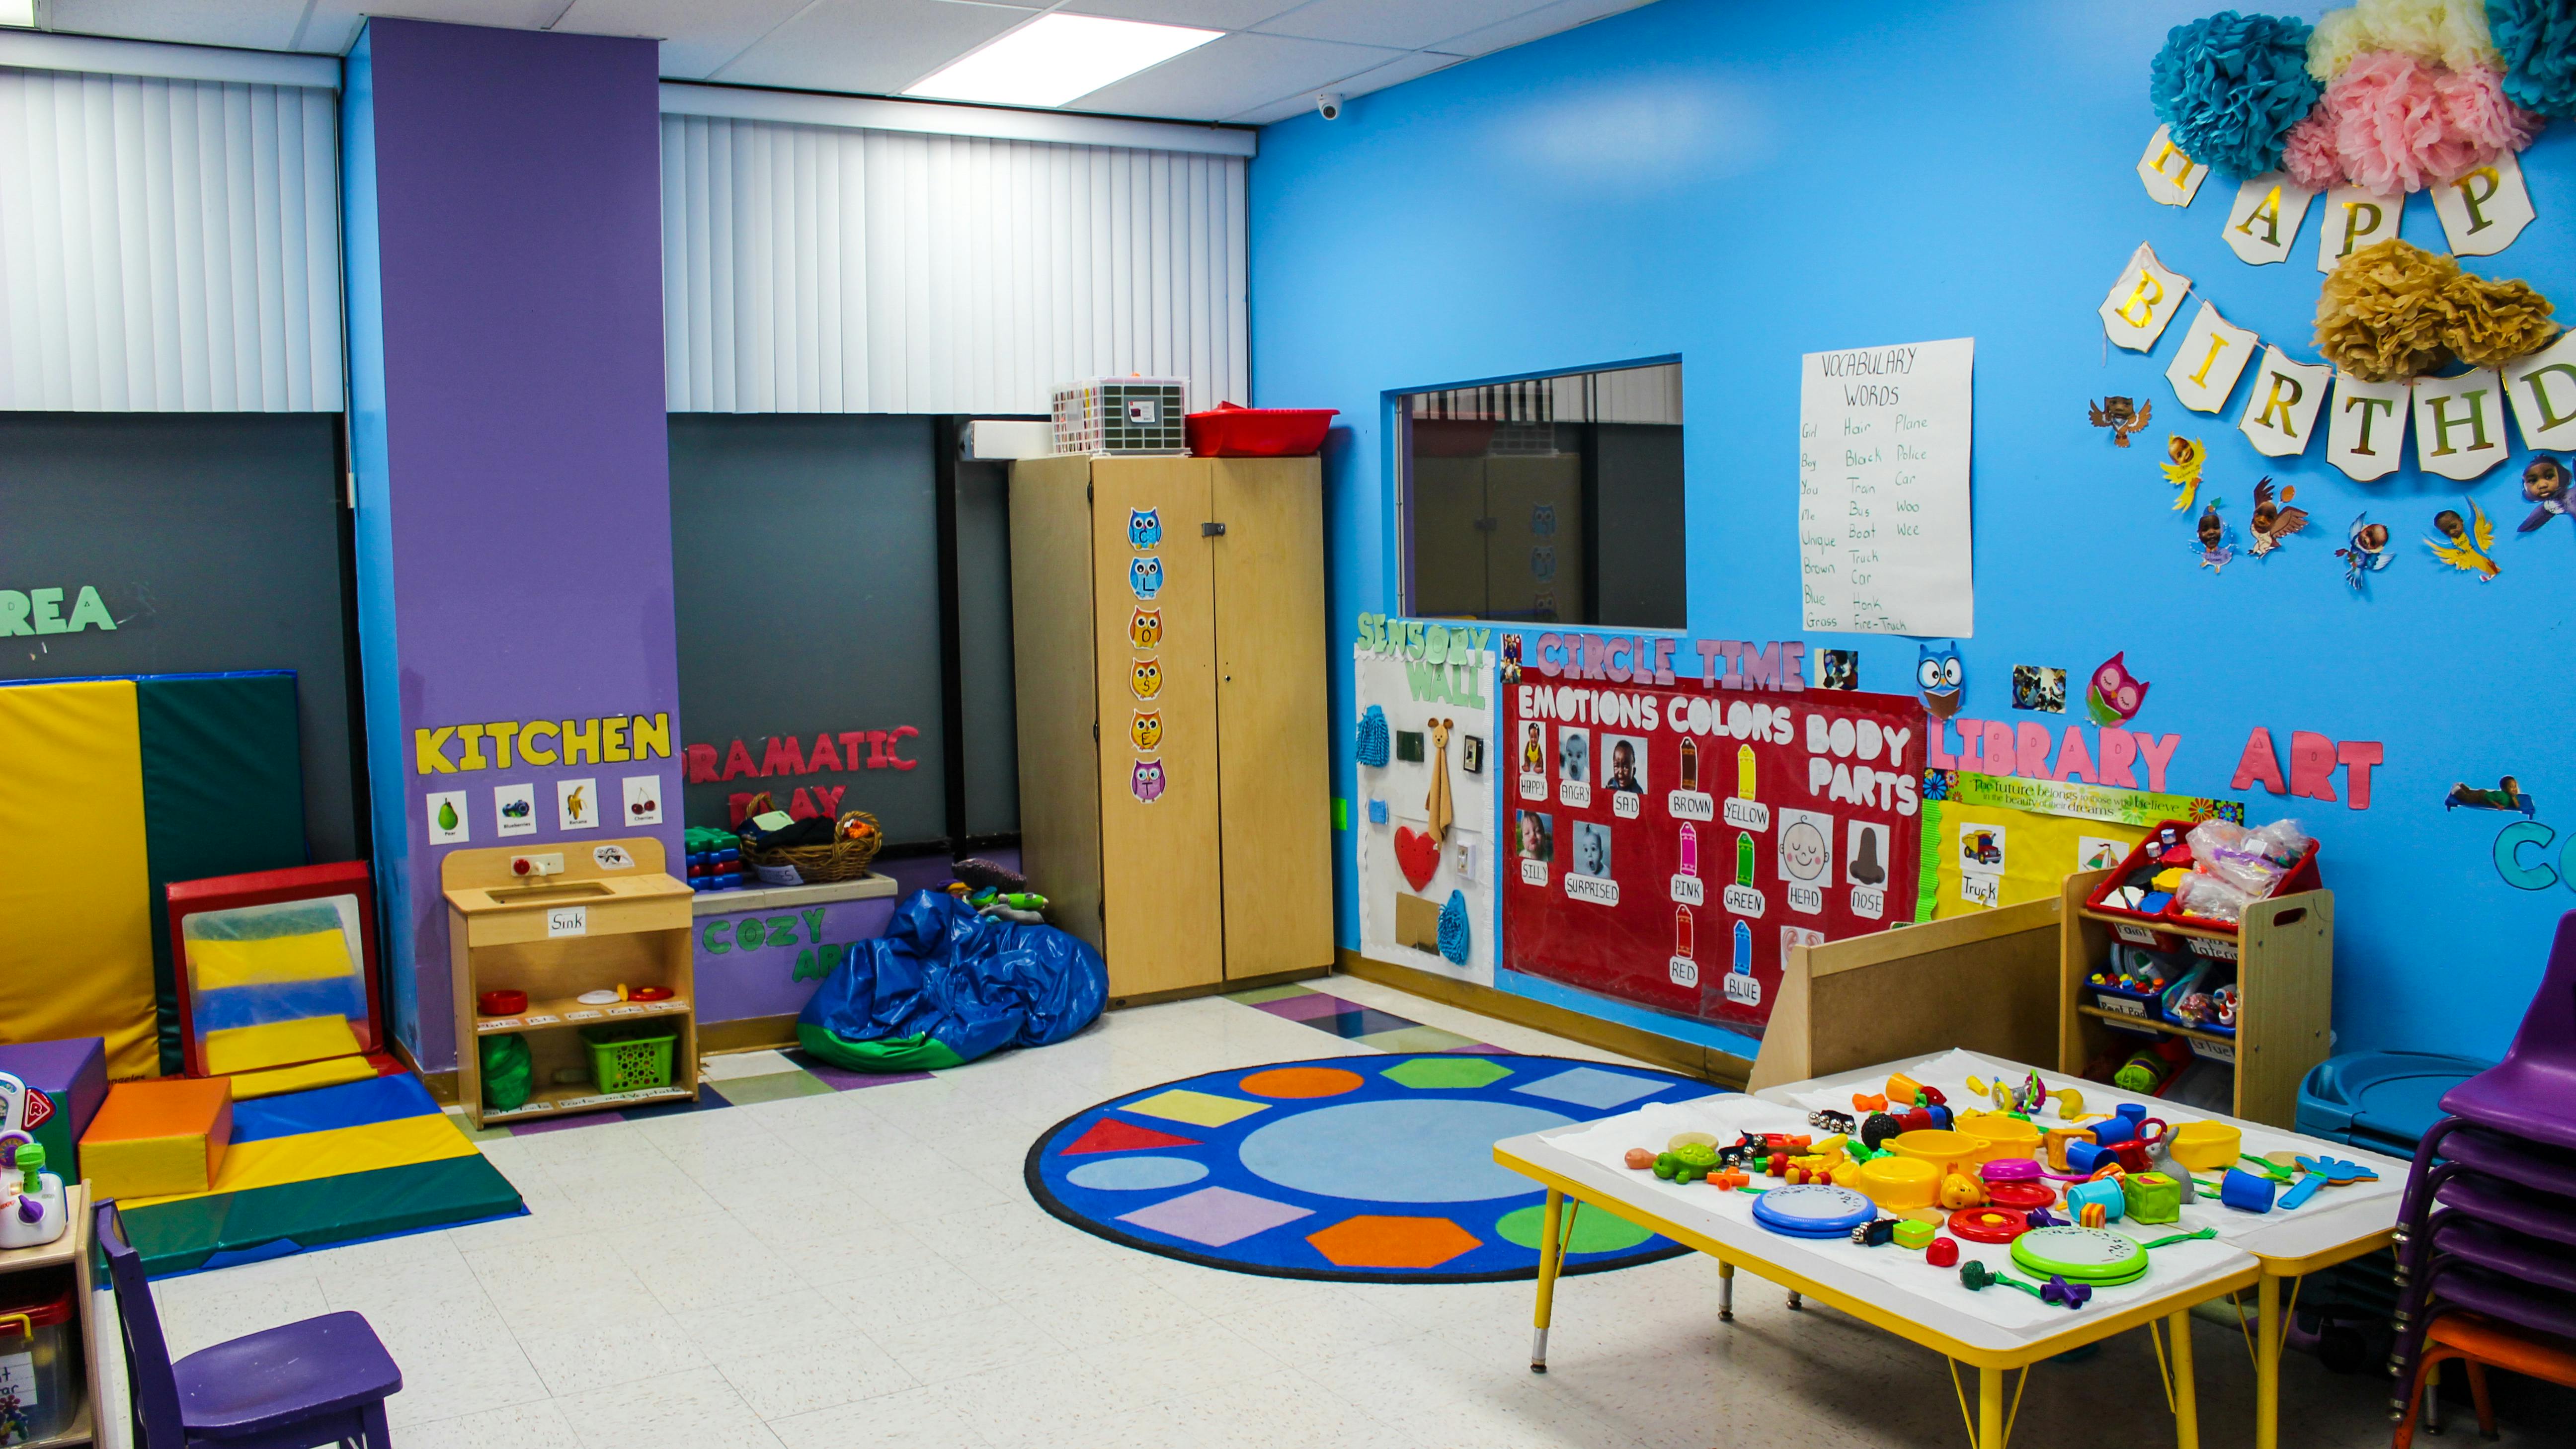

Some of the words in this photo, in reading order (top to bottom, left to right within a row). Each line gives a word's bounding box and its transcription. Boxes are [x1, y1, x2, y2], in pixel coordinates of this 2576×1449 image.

[1822, 348, 1917, 377] VOCABULARY
[1845, 384, 1898, 406] WORDS
[1802, 423, 1817, 438] Girl
[1845, 417, 1870, 436] Hair
[1895, 414, 1928, 433] Plane
[1801, 453, 1816, 471] Boy
[1846, 447, 1882, 467] Black
[1897, 444, 1927, 461] Police
[1801, 479, 1818, 495] You
[1847, 477, 1875, 494] Train
[1895, 471, 1916, 485] Car
[1801, 509, 1815, 521] Me
[1849, 500, 1869, 517] Bus
[1897, 500, 1919, 512] Woo
[1849, 523, 1876, 539] Boat
[1897, 523, 1920, 536] Wee
[1802, 531, 1836, 555] Unique
[1804, 557, 1835, 574] Brown
[1849, 549, 1878, 564] Truck
[1852, 569, 1871, 585] Car
[1805, 584, 1826, 606] Blue
[1853, 592, 1882, 611] Honk
[1807, 612, 1837, 628] Grass
[1357, 612, 1491, 668] SENSORY
[1537, 633, 1676, 685] CIRCLE
[1697, 640, 1805, 692] TIME
[1405, 661, 1485, 710] WALL
[1518, 685, 1659, 731] EMOTIONS
[1667, 697, 1794, 745] COLORS
[415, 713, 671, 775] KITCHEN
[1806, 714, 1911, 767] BODY
[681, 725, 918, 784] RAMATIC
[1931, 716, 2181, 793] LIBRARY
[2230, 726, 2383, 809] ART
[1521, 779, 1545, 795] HAPPY
[1562, 784, 1590, 802] ANGRY
[1809, 757, 1918, 816] PARTS
[1996, 780, 2033, 795] future
[2037, 784, 2077, 801] belongs
[2135, 795, 2179, 812] believe
[1615, 797, 1638, 813] SAD
[1674, 796, 1711, 814] BROWN
[2006, 794, 2036, 806] beauty
[2047, 801, 2067, 809] their
[1724, 801, 1768, 825] YELLOW
[2494, 821, 2576, 893] C
[1523, 864, 1547, 881] SILLY
[1567, 878, 1618, 900] SURPRISED
[1675, 880, 1700, 898] PINK
[1790, 887, 1819, 906] HEAD
[1963, 876, 1996, 899] Truck
[1725, 892, 1762, 911] GREEN
[1852, 892, 1882, 912] NOSE
[552, 912, 582, 931] Sink
[702, 907, 825, 954] COZY
[1672, 961, 1695, 981] RED
[1729, 979, 1757, 1000] BLUE
